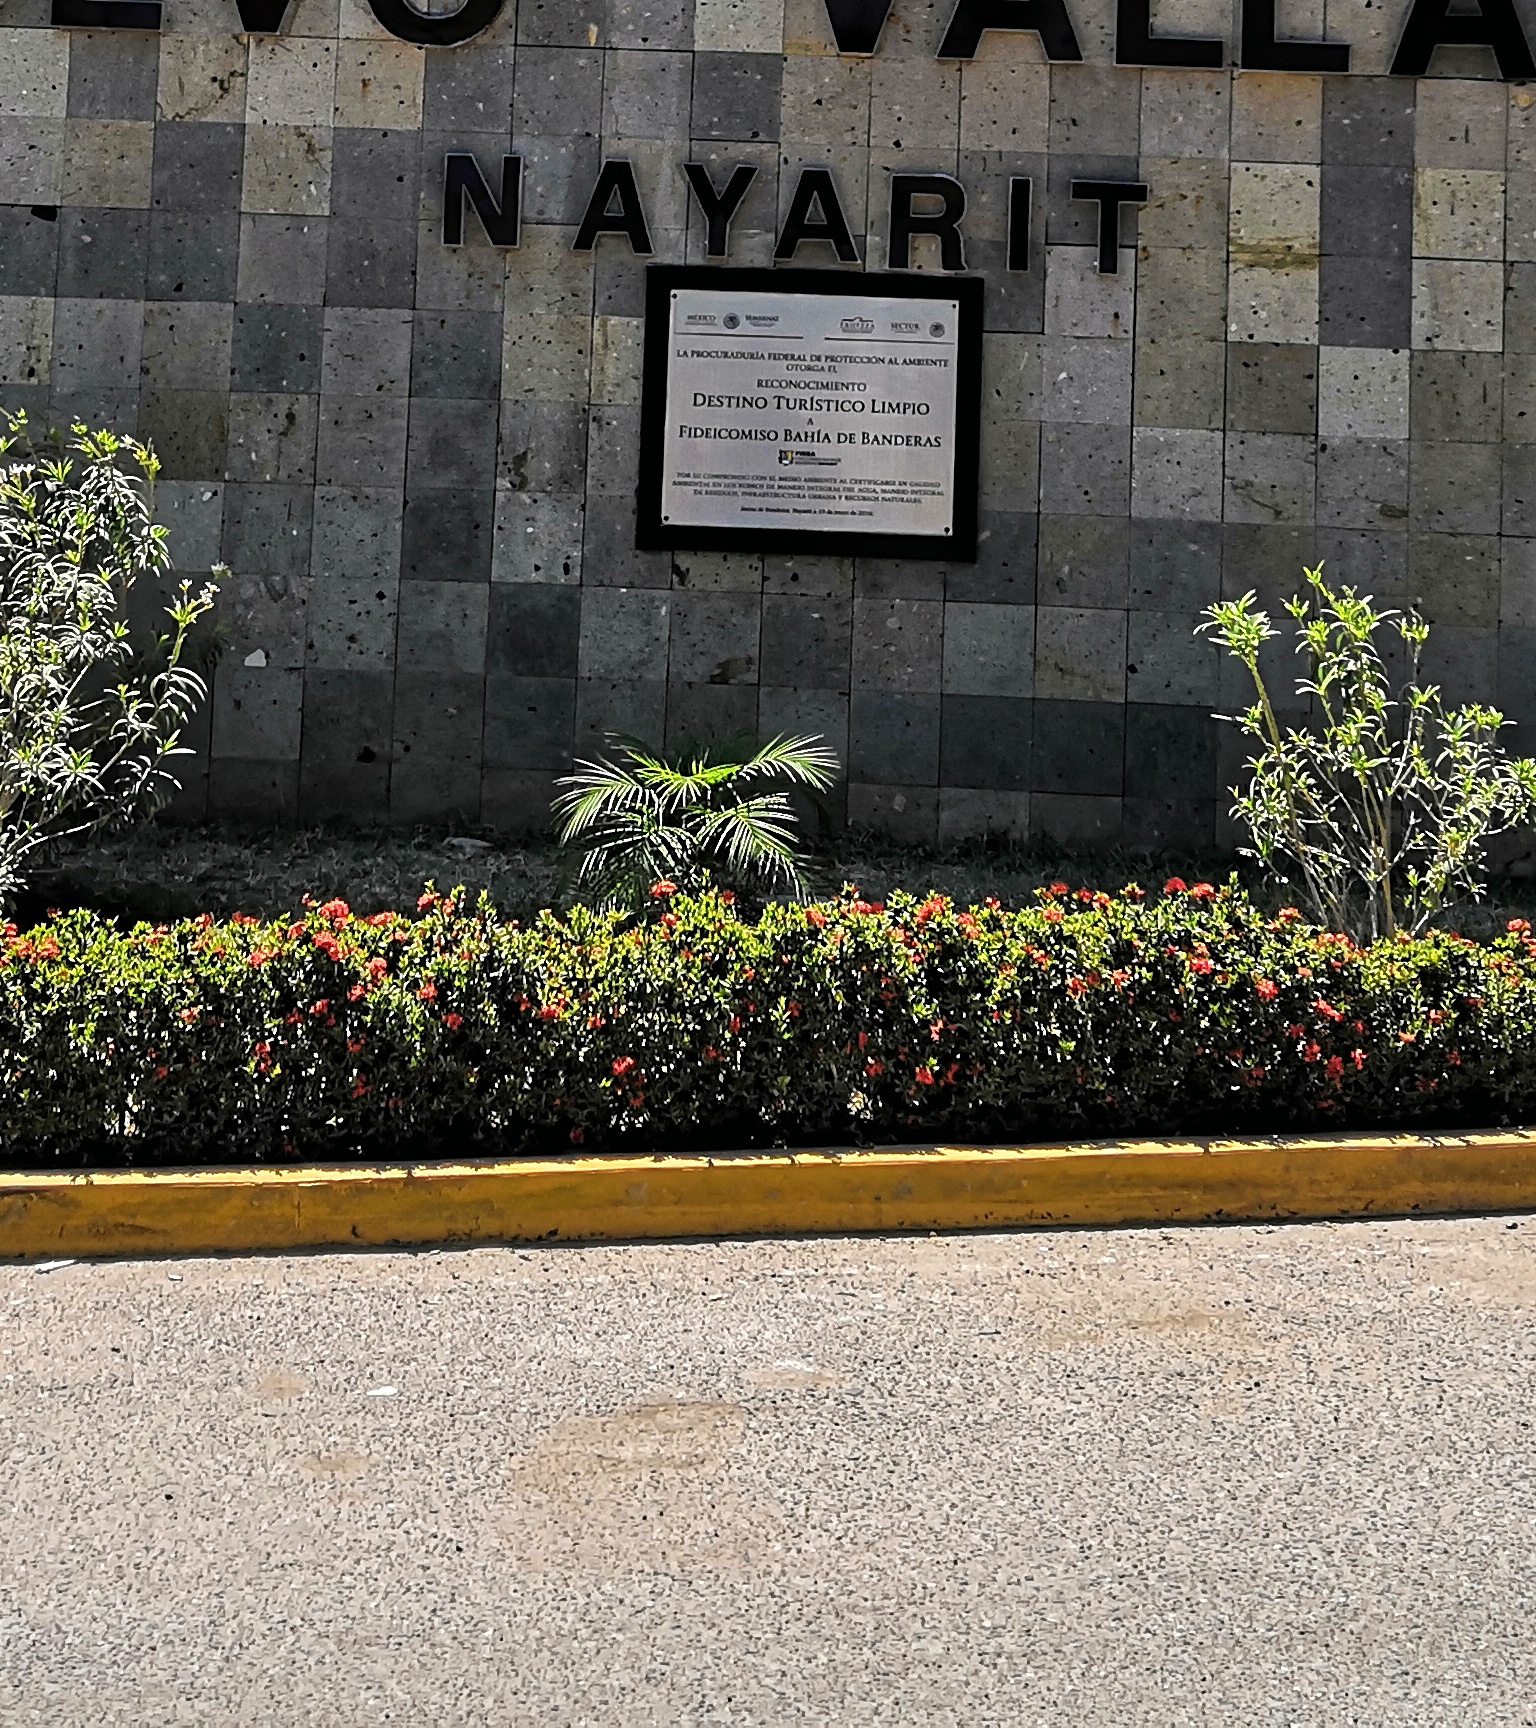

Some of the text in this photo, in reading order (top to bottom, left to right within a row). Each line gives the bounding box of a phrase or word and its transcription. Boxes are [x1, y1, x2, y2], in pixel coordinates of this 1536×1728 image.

[441, 152, 1149, 275] NAYARIT
[676, 349, 689, 358] LA
[768, 352, 807, 362] FEDERAL
[810, 354, 822, 362] DE
[888, 357, 899, 365] AL
[901, 357, 949, 367] AMBIENTE
[786, 363, 825, 372] OTORGA
[756, 378, 867, 392] RECONOCIMIENTO
[692, 392, 930, 415] DESTINO TURÍSTICO LIMPIO
[807, 417, 814, 425] A
[679, 425, 942, 447] FIDEICOMISO BAHÍA DE BANDERAS
